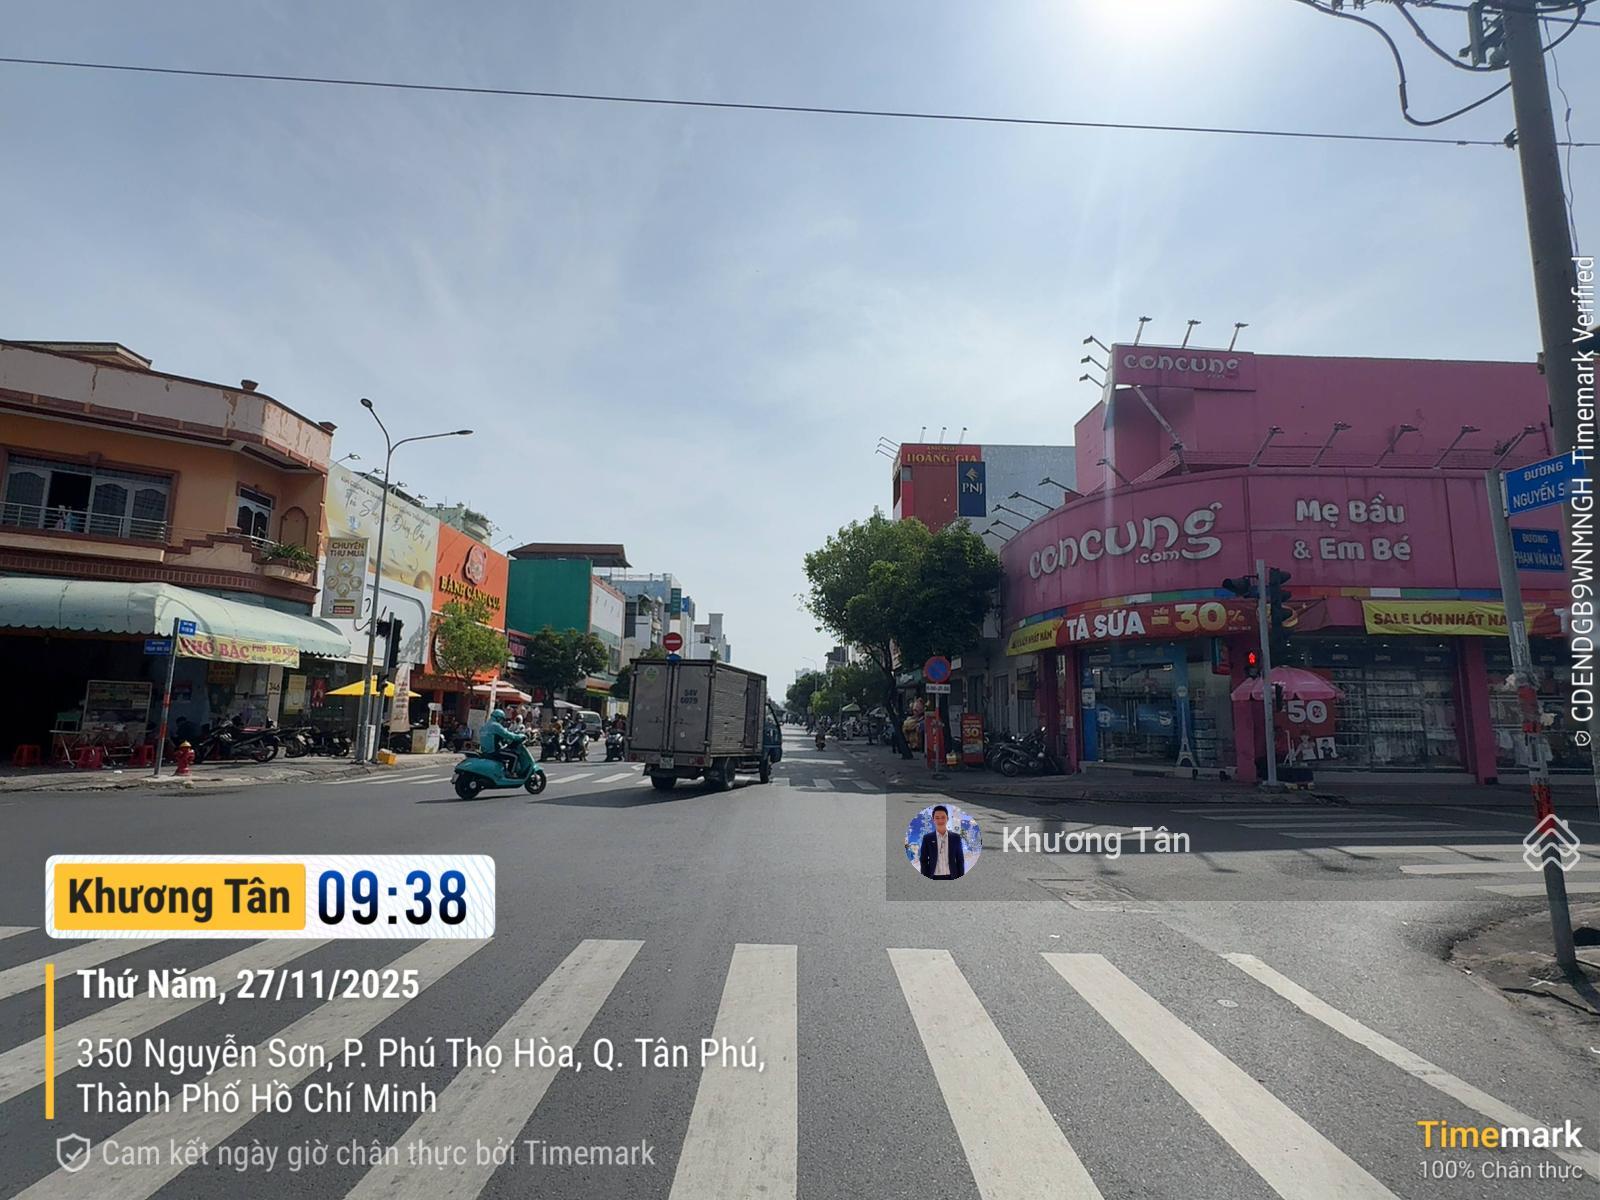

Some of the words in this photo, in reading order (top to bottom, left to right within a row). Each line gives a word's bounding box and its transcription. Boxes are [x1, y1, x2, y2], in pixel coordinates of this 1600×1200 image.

[962, 482, 983, 495] PNJ
[1295, 499, 1340, 528] Mẹ
[1348, 493, 1406, 524] Bầu
[1136, 548, 1180, 565] .com
[1292, 541, 1311, 560] &
[1319, 537, 1365, 560] Em
[1372, 535, 1412, 561] Bé
[1373, 612, 1409, 626] SALE
[1412, 610, 1442, 626] LỚN
[1443, 610, 1485, 626] NHẤT
[219, 638, 250, 659] BẮC
